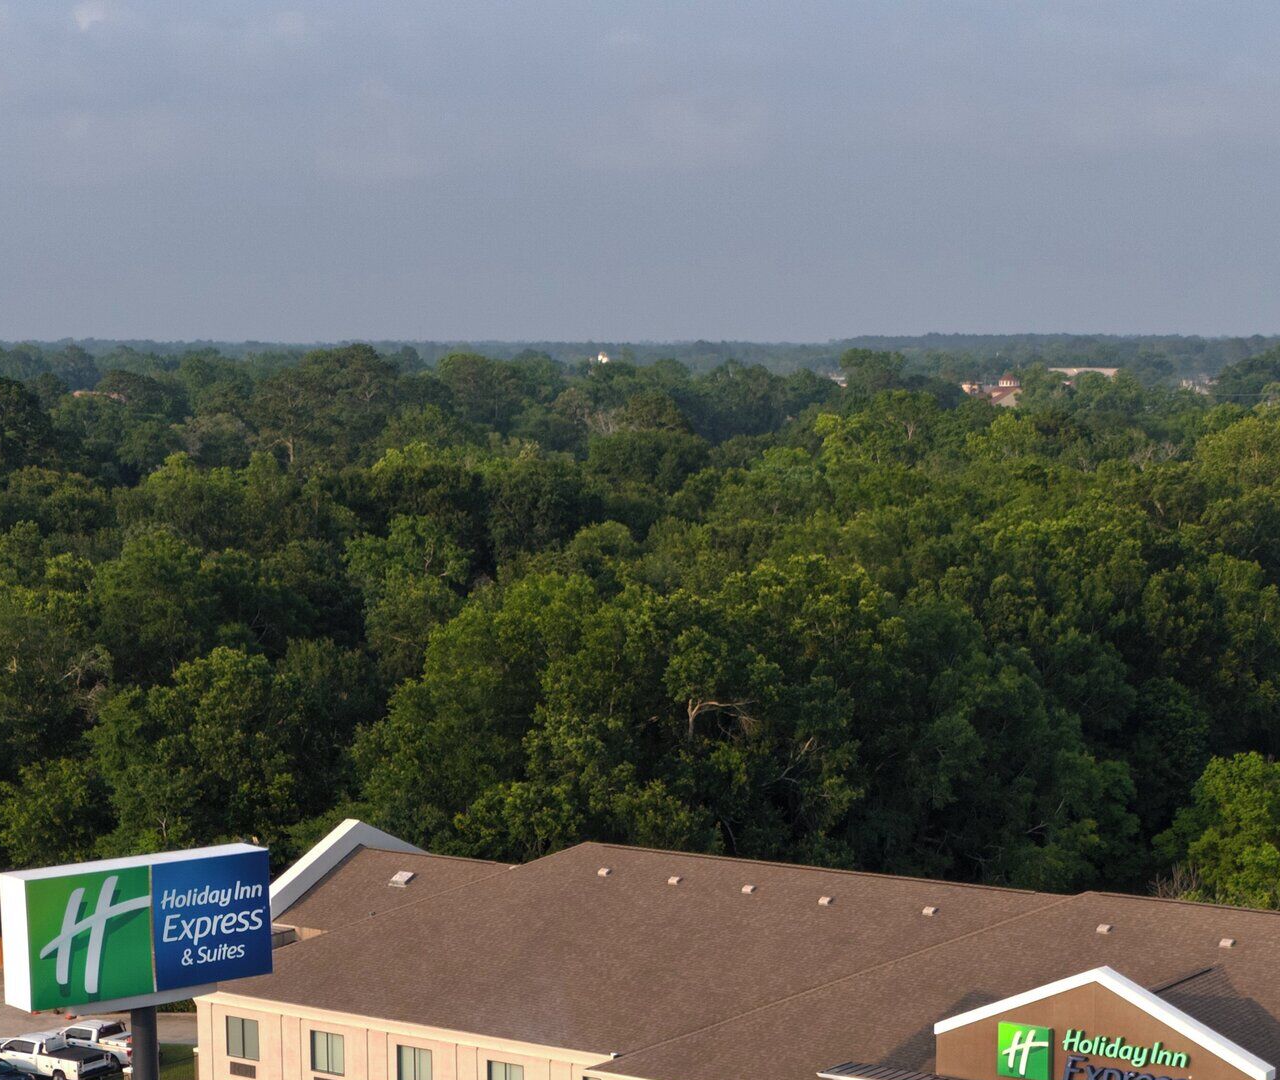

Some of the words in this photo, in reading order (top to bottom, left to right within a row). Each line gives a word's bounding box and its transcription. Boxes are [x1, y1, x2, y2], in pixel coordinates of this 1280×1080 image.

[161, 885, 232, 910] Holiday
[234, 880, 262, 901] Inn
[162, 908, 263, 946] Express
[181, 948, 194, 967] &
[196, 943, 245, 965] Suites
[1062, 1029, 1148, 1068] Holiday
[1150, 1041, 1188, 1069] Inn
